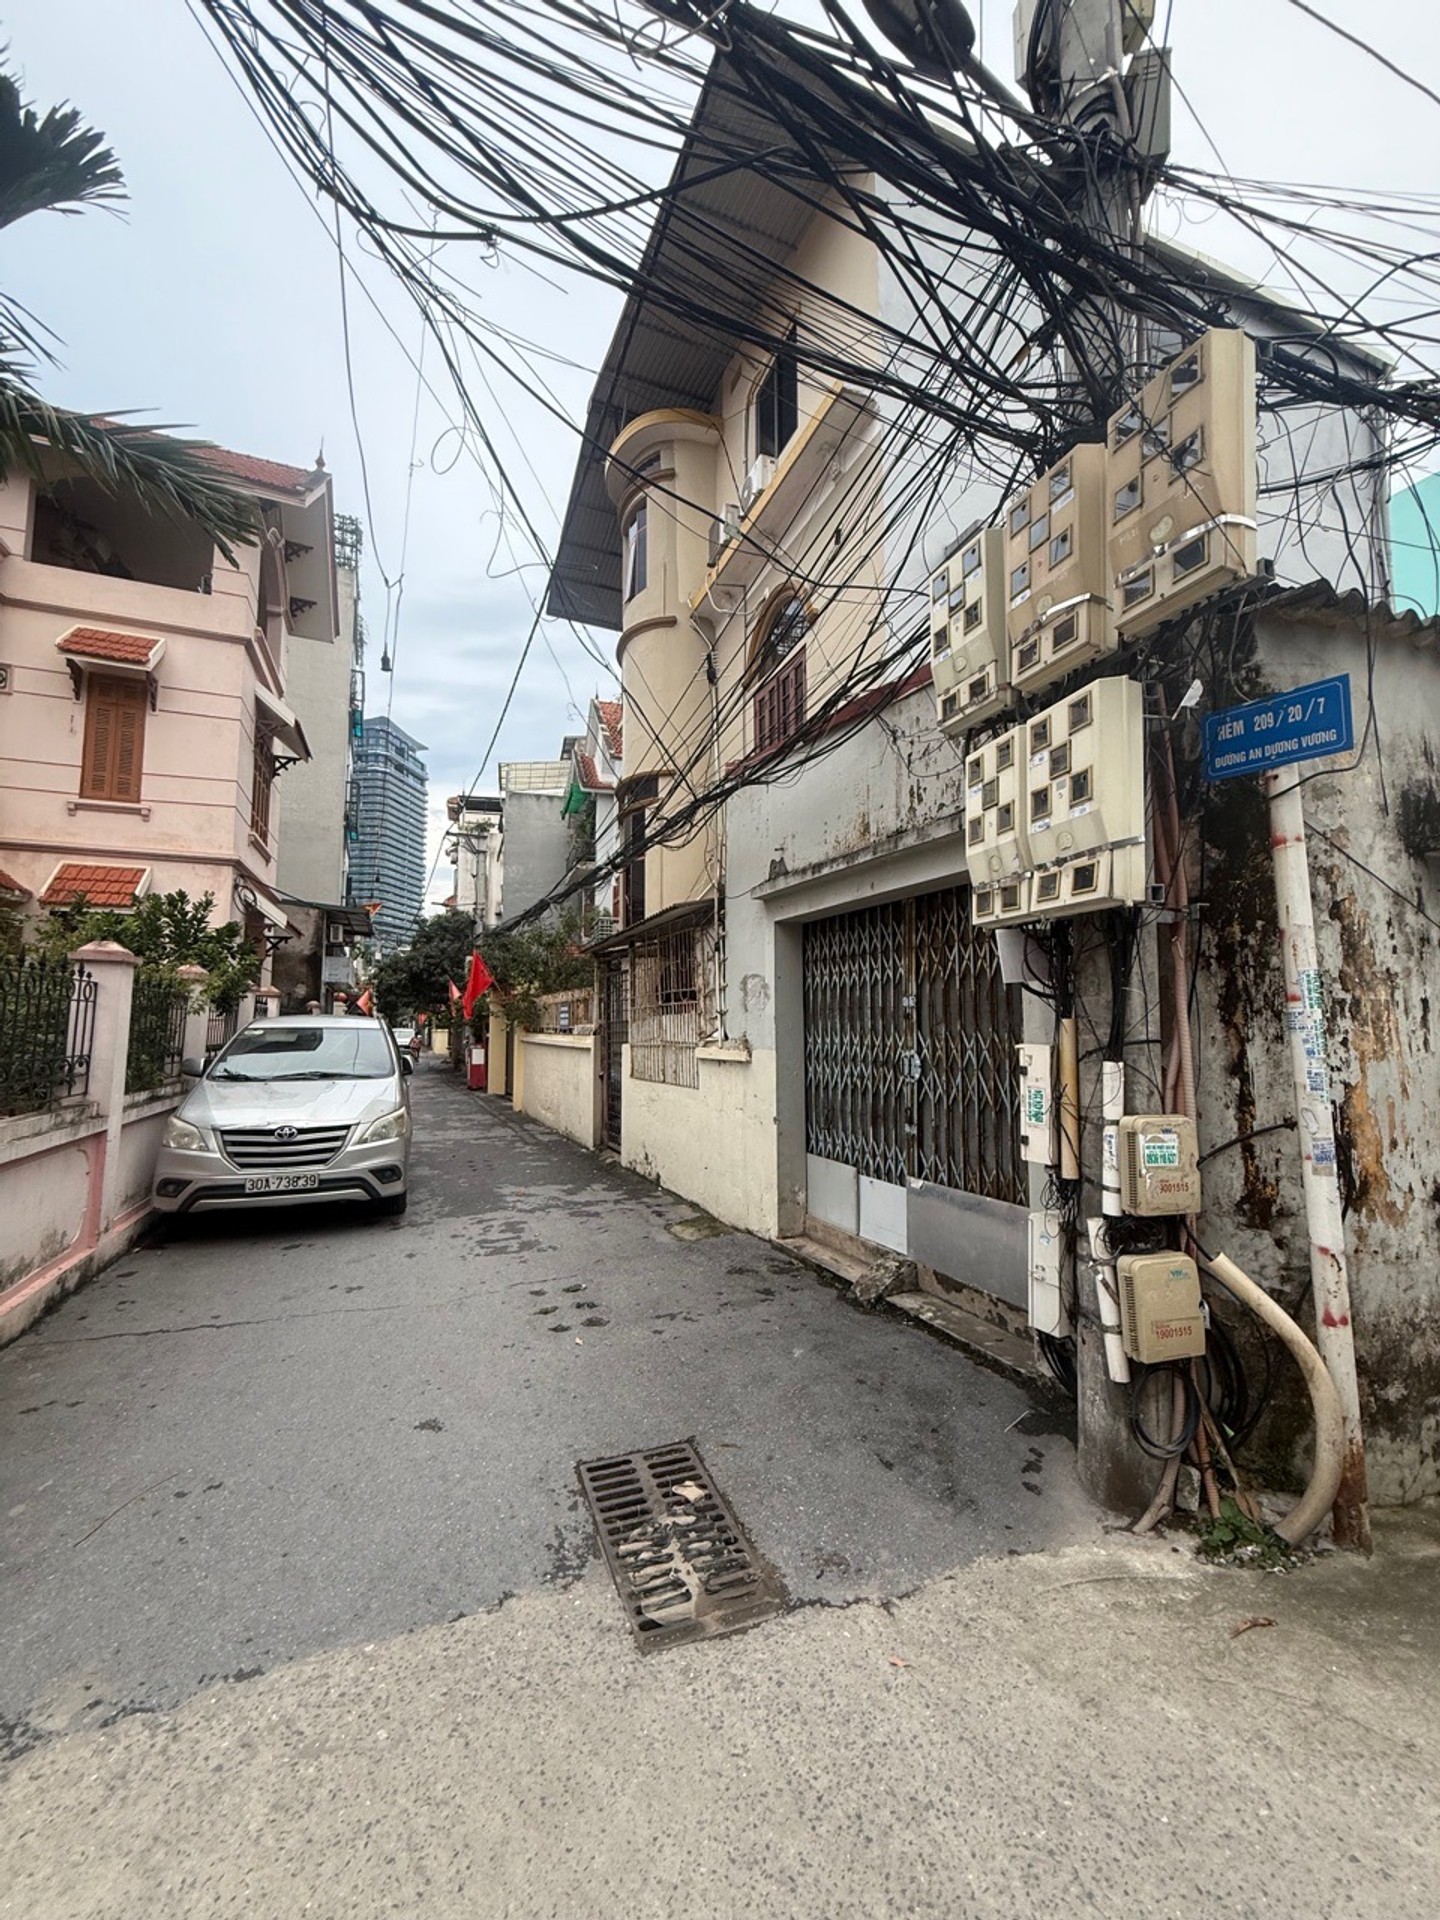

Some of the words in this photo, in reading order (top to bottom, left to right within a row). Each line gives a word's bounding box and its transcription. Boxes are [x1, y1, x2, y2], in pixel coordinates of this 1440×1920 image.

[1217, 716, 1244, 741] HẺM
[1248, 747, 1263, 760] AN
[1264, 739, 1299, 757] DƯƠNG
[1301, 729, 1337, 748] VƯƠNG
[1156, 1326, 1193, 1340] 19001515
